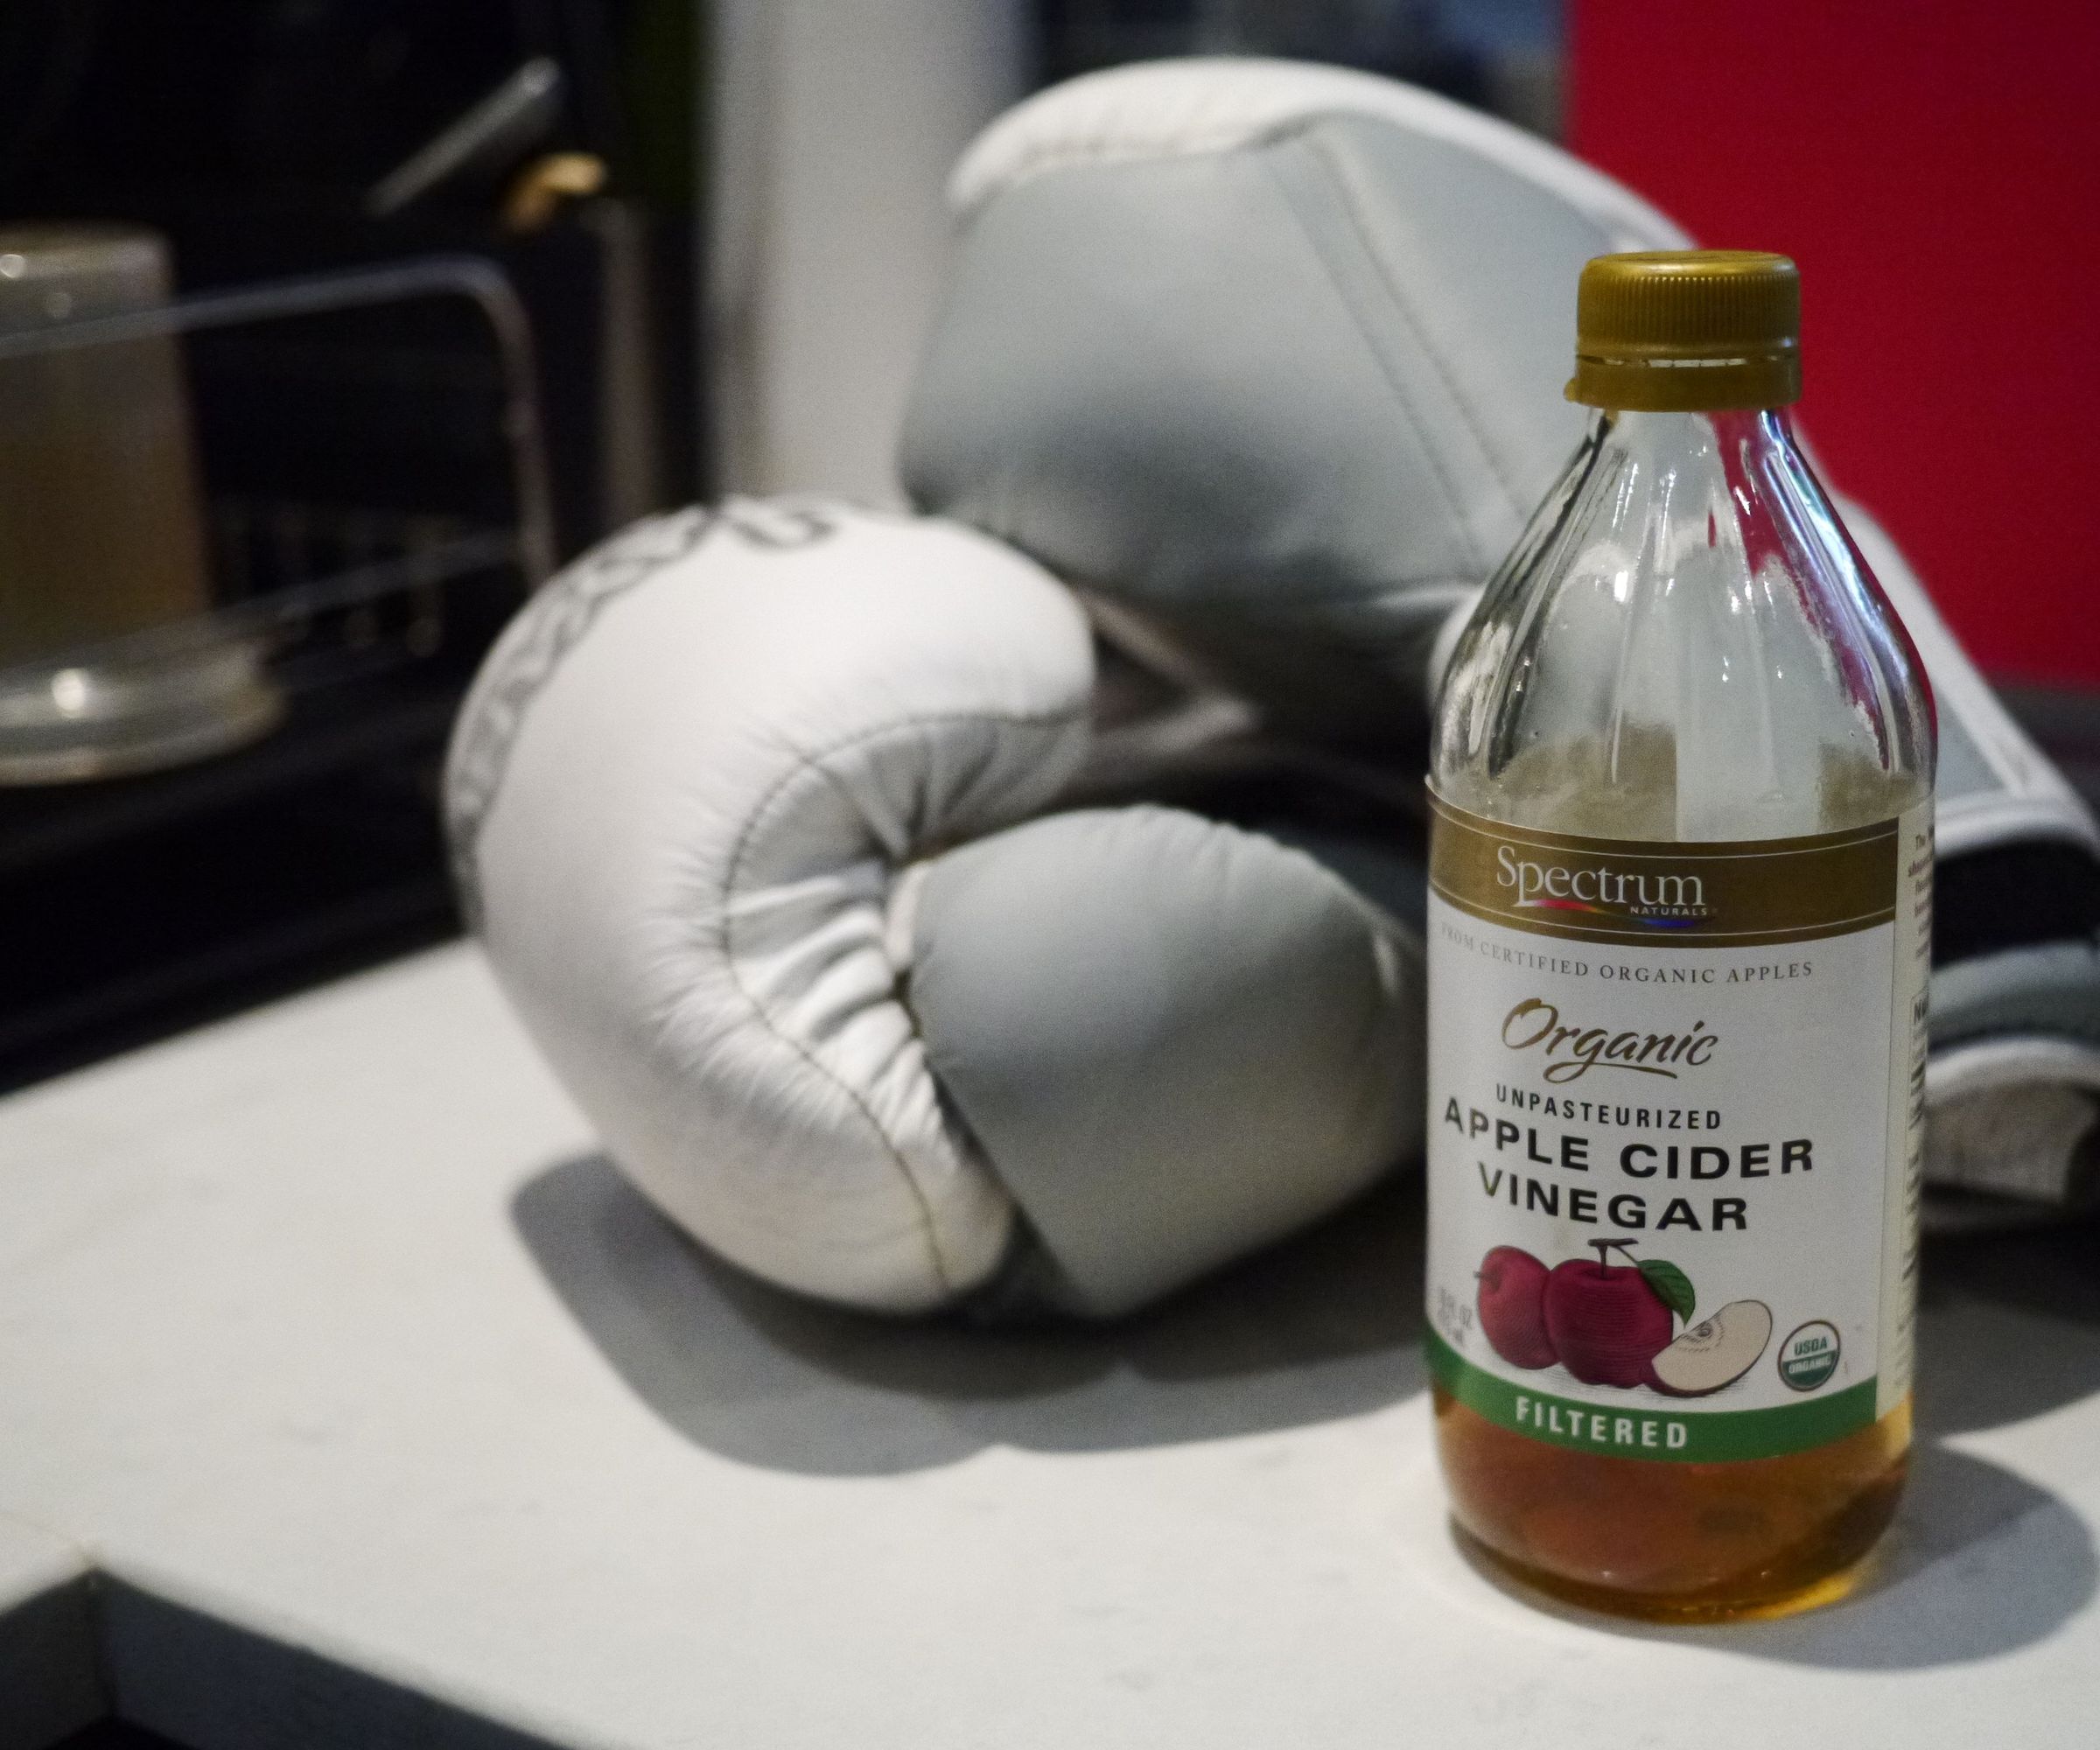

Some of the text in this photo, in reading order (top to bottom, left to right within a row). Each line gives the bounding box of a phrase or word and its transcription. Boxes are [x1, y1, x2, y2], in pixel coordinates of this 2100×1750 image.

[1496, 845, 1705, 907] Spectrum
[1629, 906, 1708, 916] NATURALS
[1441, 921, 1814, 984] FROM CERTIFIED ORGANIC APPLES
[1502, 998, 1718, 1084] Organic
[1496, 1083, 1721, 1130] UNPASTEURIZED
[1445, 1096, 1814, 1180] APPLE CIDER
[1478, 1161, 1747, 1232] VINEGAR
[1794, 1336, 1828, 1356] USDA
[1516, 1396, 1688, 1449] FILTERED
